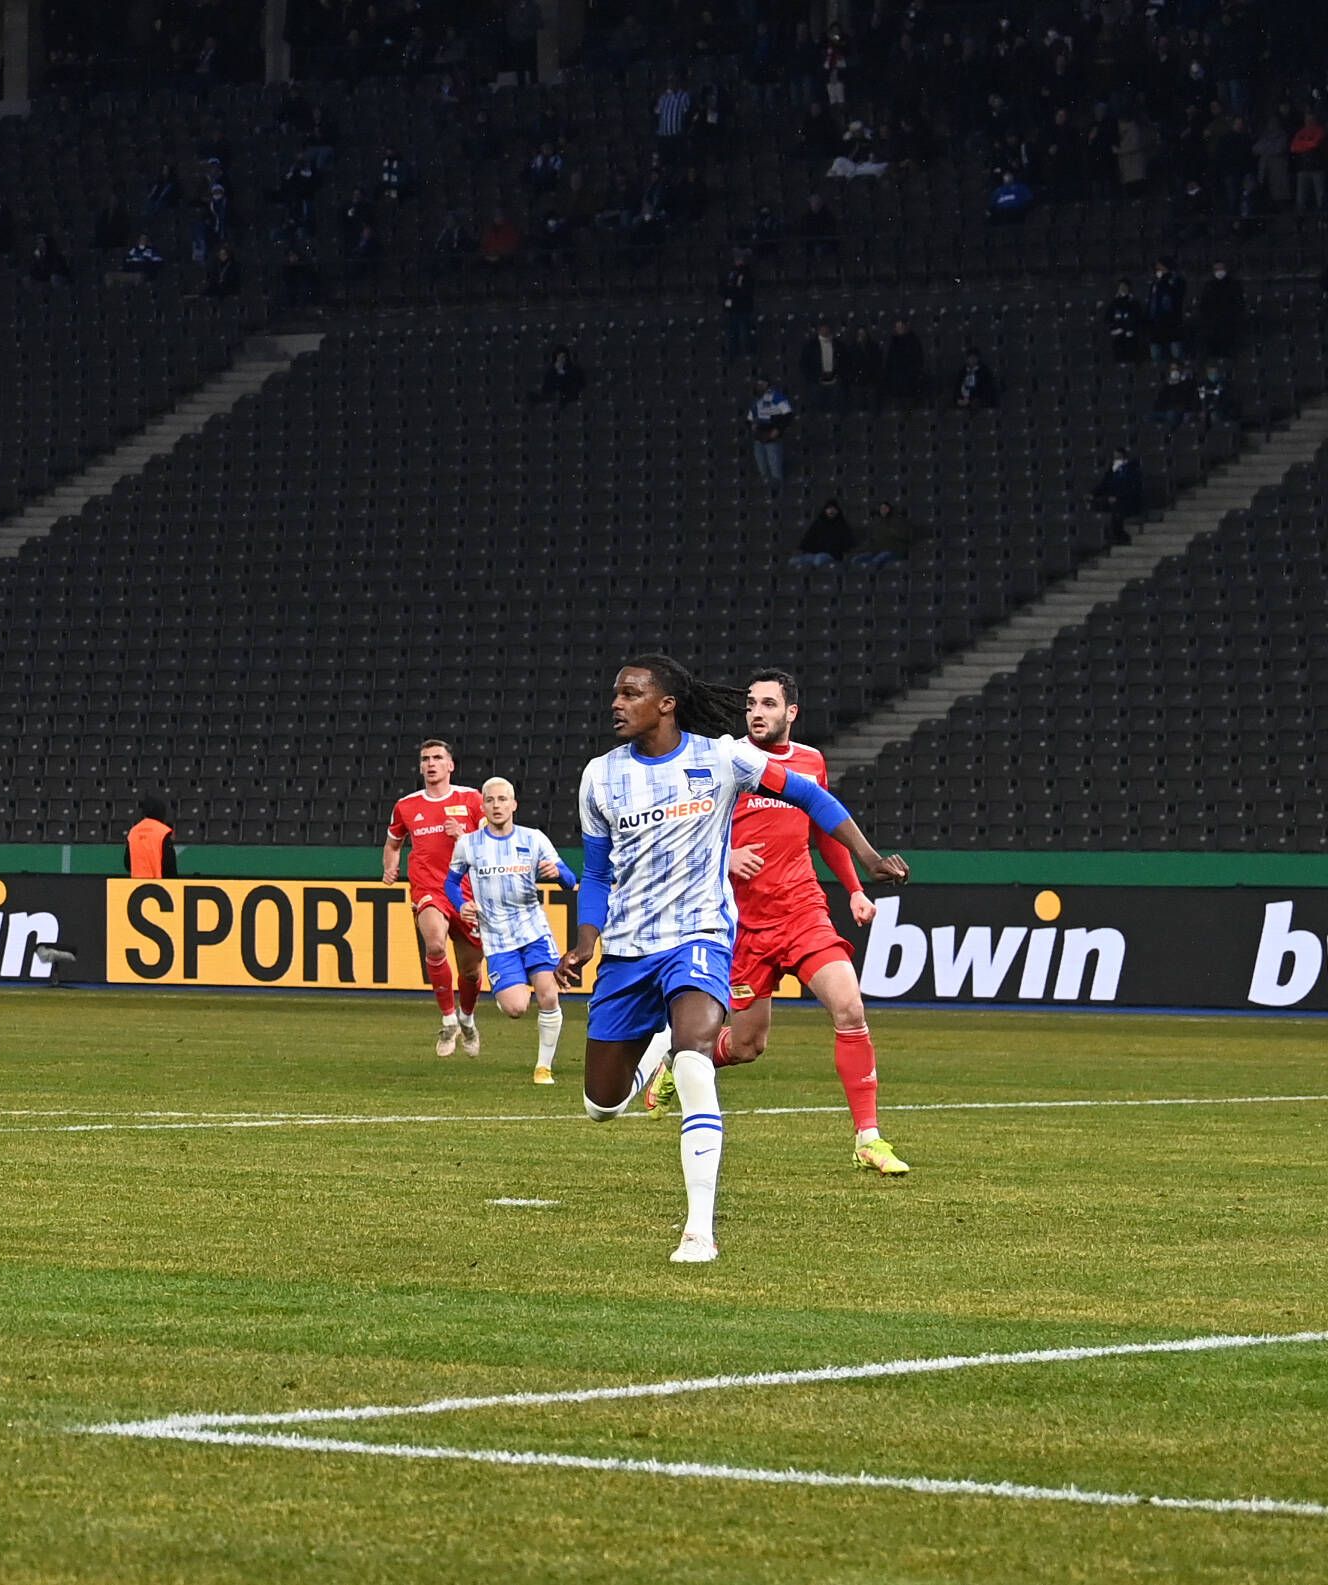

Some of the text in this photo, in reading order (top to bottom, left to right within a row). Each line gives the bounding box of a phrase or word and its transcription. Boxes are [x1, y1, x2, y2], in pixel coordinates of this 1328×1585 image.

[619, 800, 713, 830] AUTOHERO
[692, 945, 709, 974] 4
[860, 890, 1126, 1001] bwin
